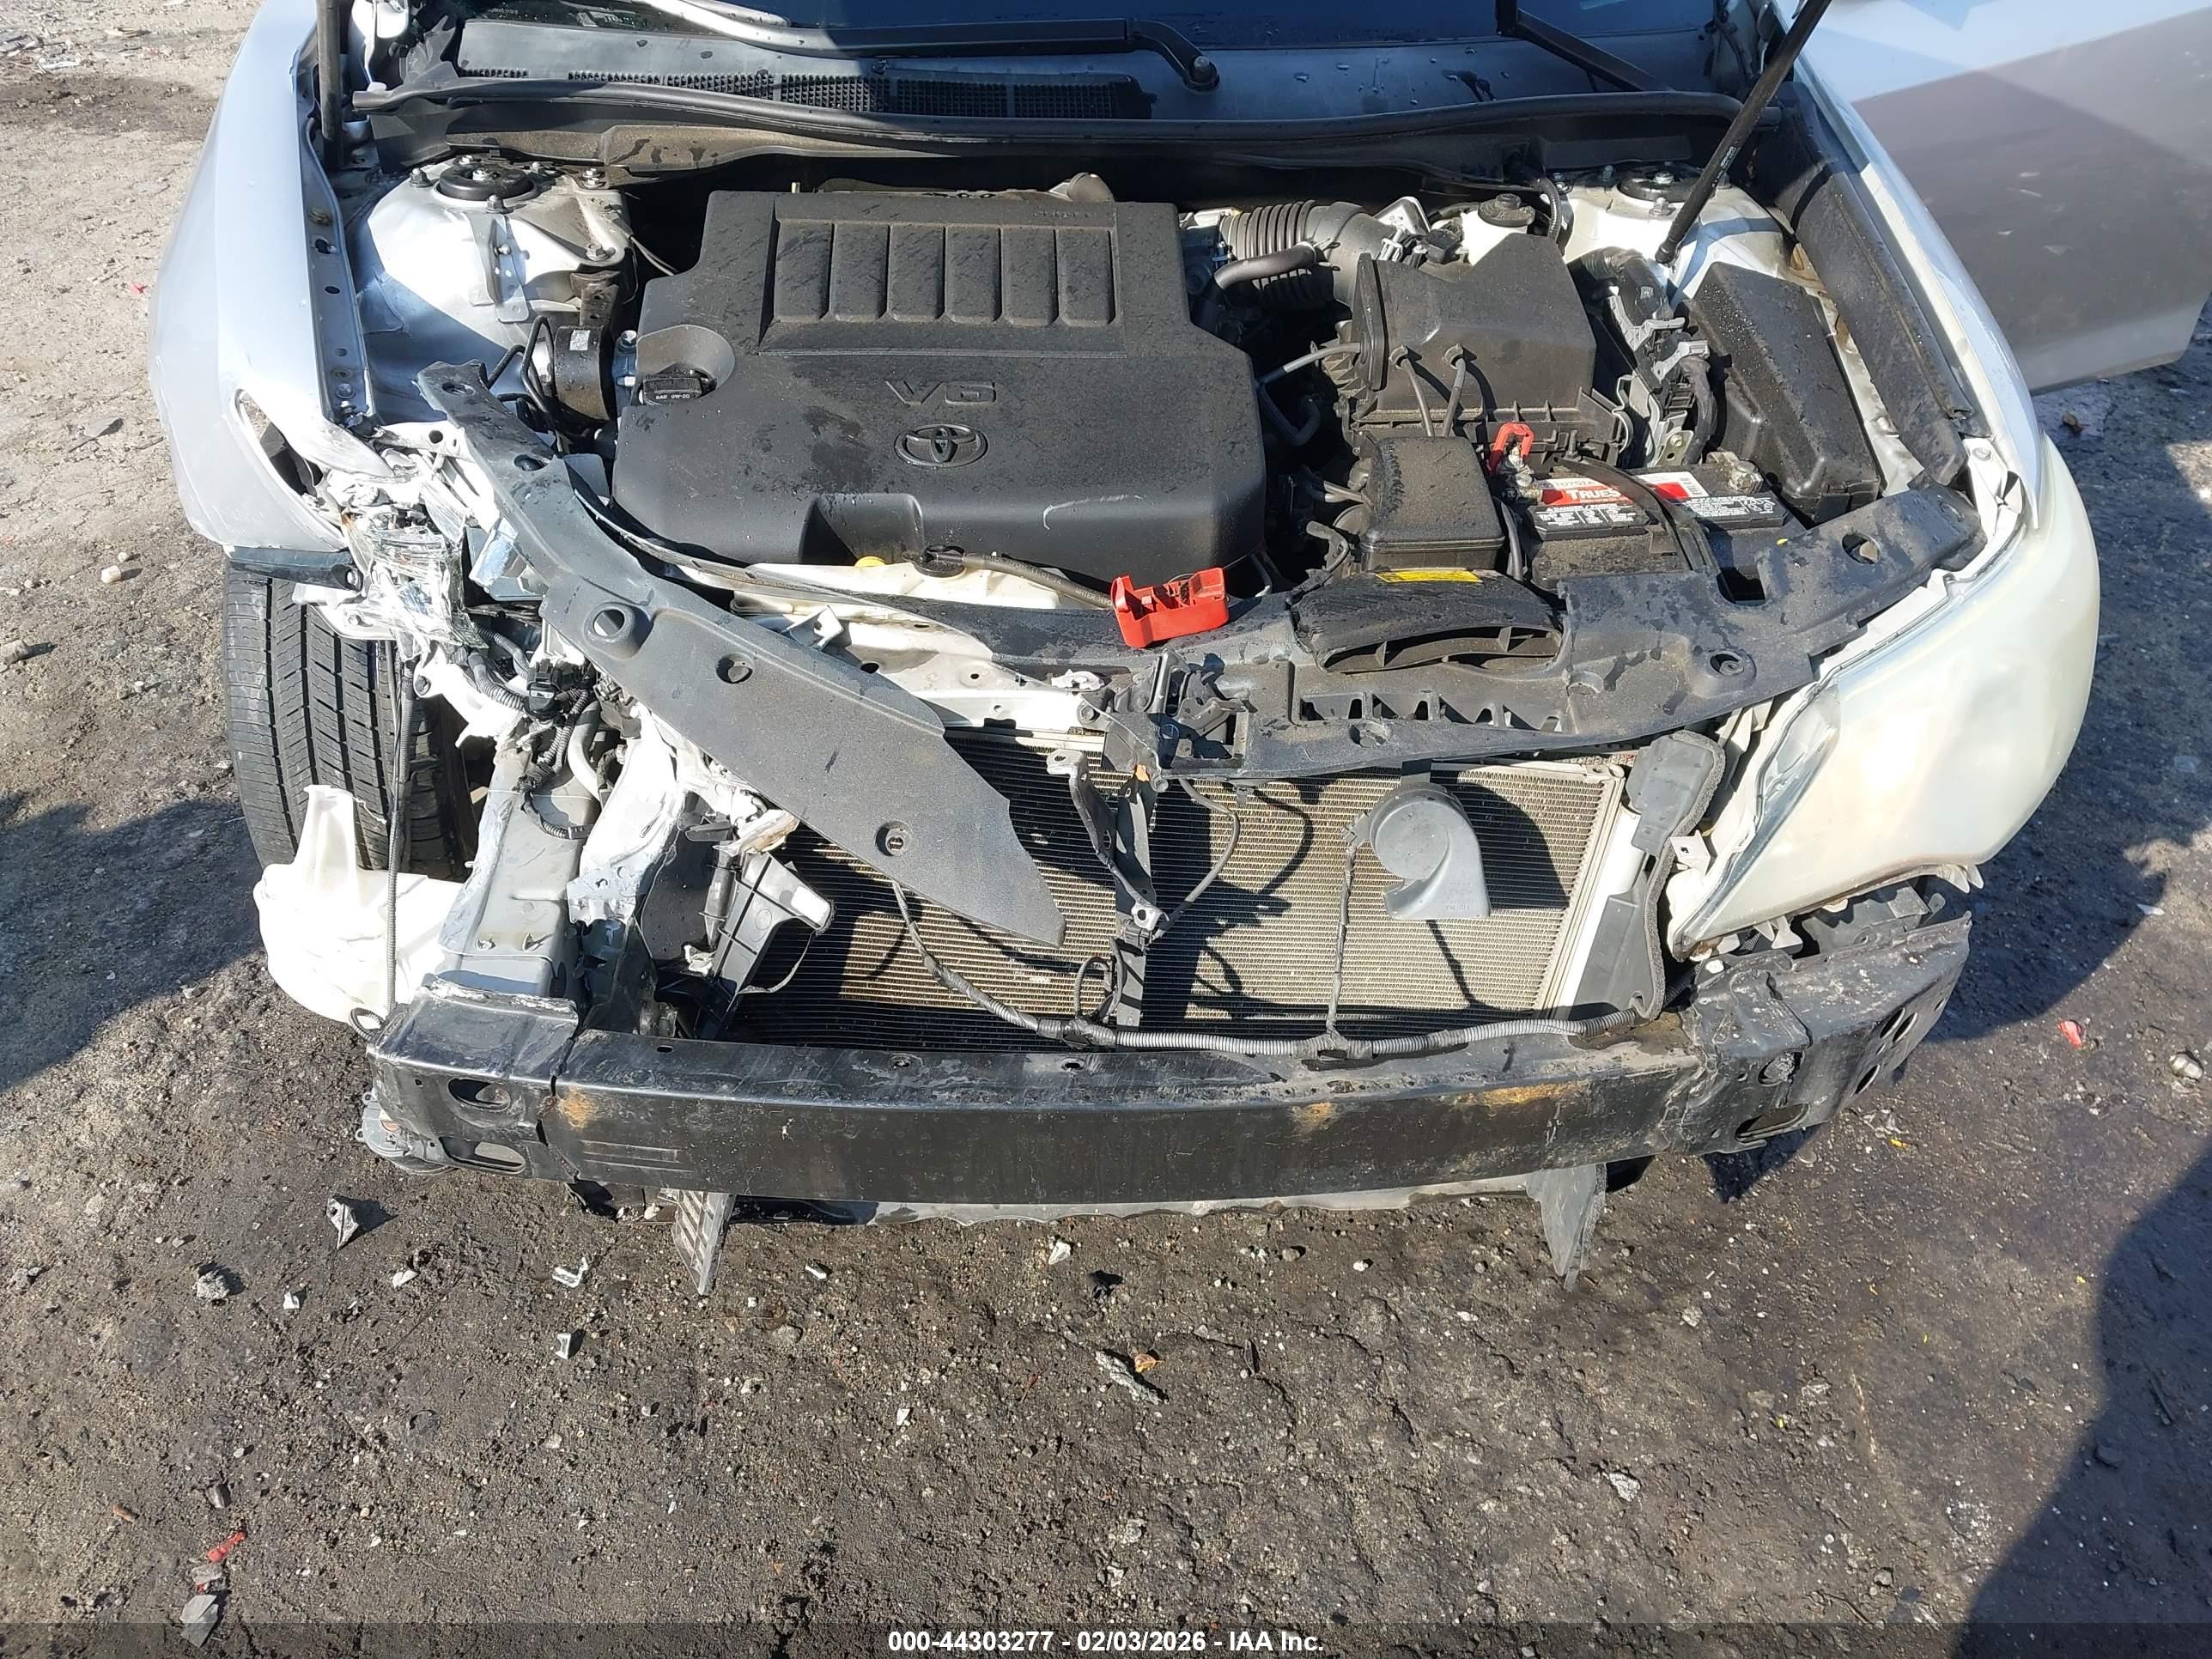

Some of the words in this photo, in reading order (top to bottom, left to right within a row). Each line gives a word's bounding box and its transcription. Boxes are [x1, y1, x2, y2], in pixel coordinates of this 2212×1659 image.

[884, 380, 998, 407] V6
[1555, 479, 1597, 488] TOYOTA
[1075, 587, 1097, 600] WATER
